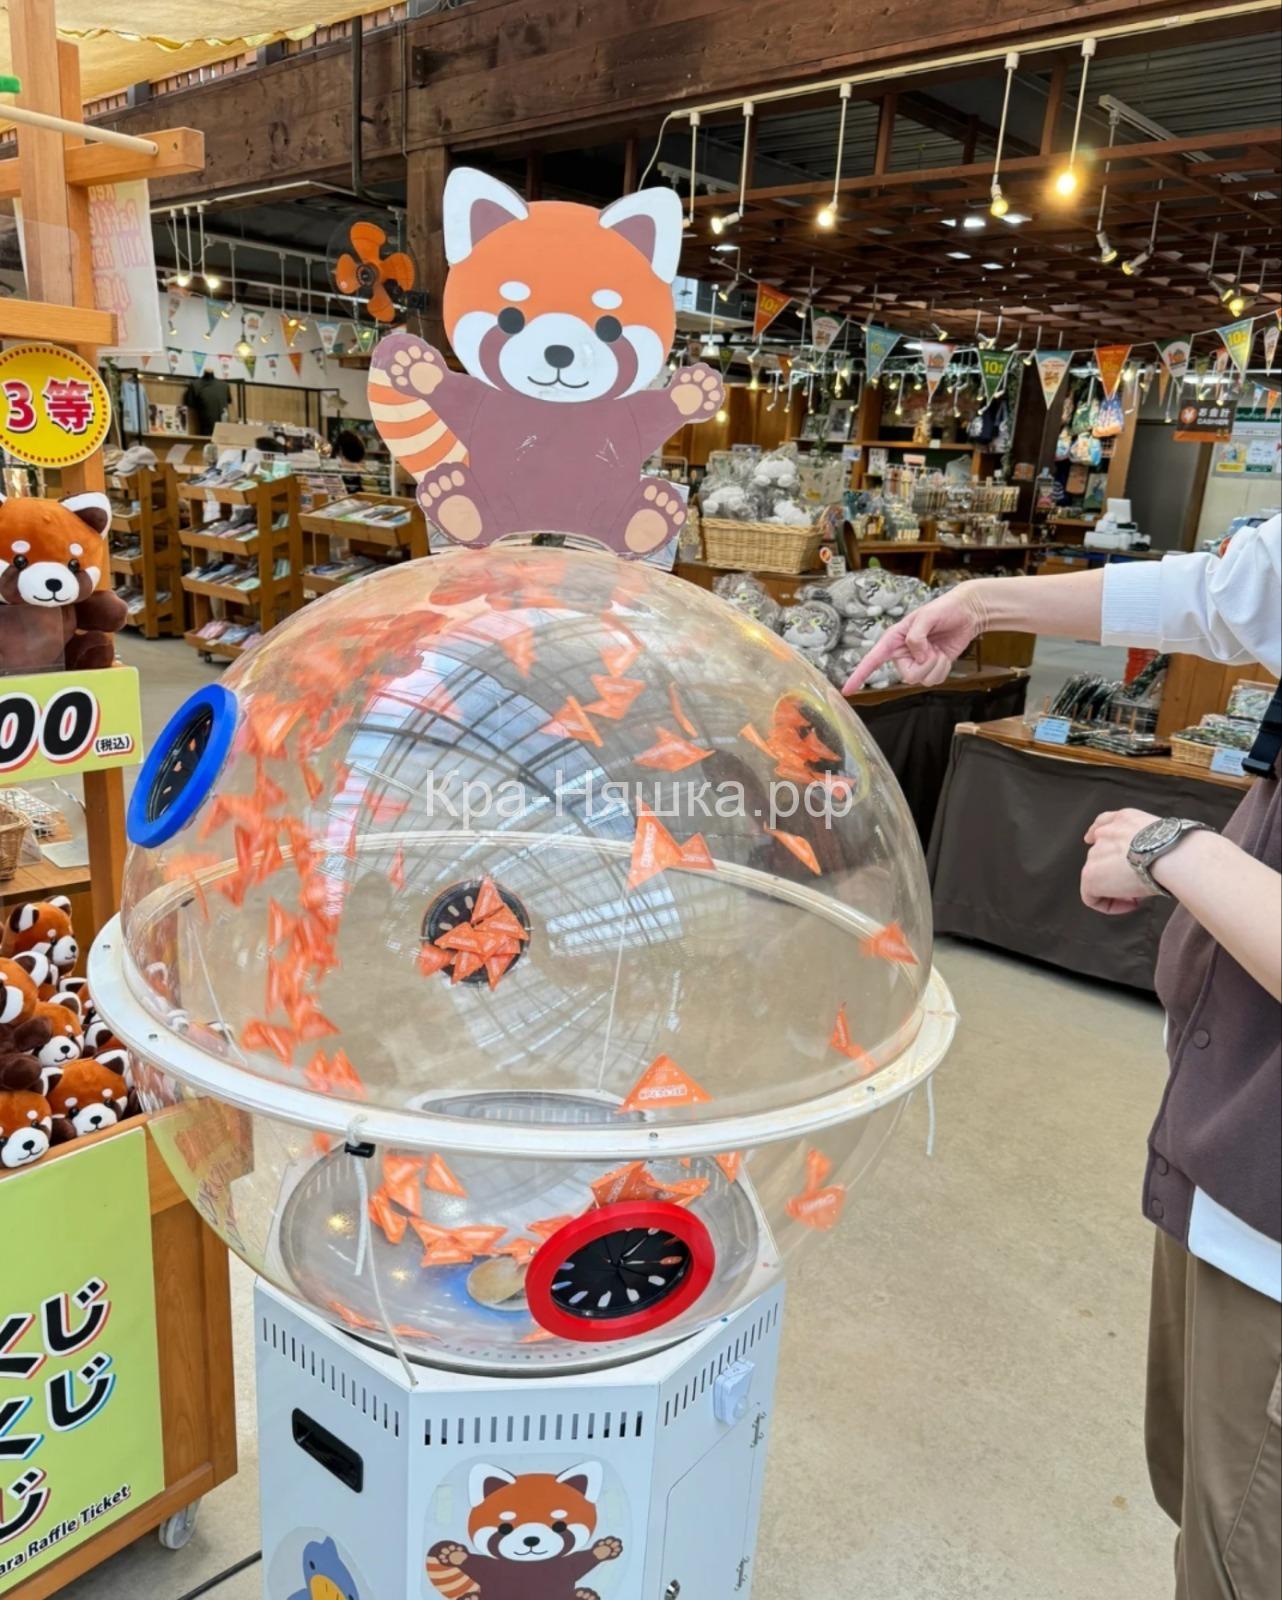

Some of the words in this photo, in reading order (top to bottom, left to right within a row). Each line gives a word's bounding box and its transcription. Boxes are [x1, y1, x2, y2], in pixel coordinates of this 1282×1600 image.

[3, 377, 94, 434] 3等
[95, 736, 130, 753] (税込)
[28, 1518, 78, 1557] Raffle
[80, 1486, 129, 1523] Ticket
